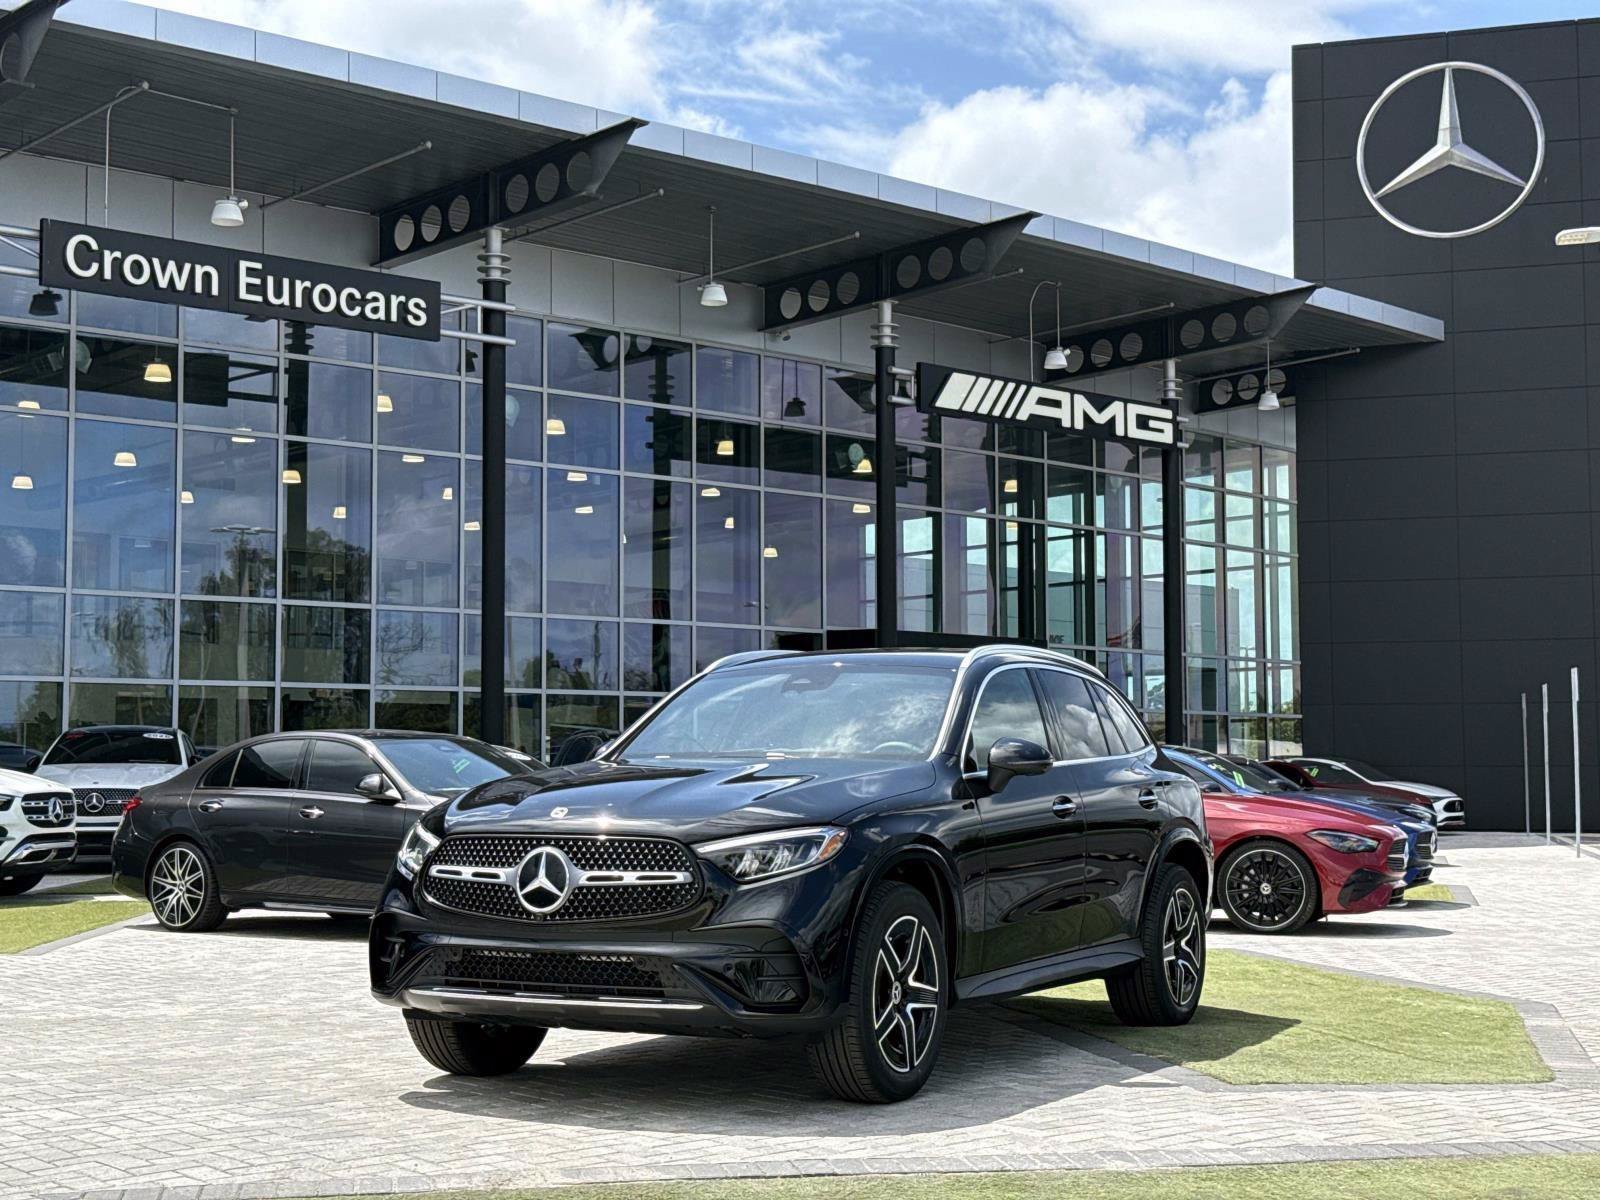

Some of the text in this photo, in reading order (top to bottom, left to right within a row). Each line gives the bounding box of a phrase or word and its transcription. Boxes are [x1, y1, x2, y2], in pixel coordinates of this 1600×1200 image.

[65, 233, 428, 327] Crown Eurocars
[1015, 386, 1174, 444] AMG
